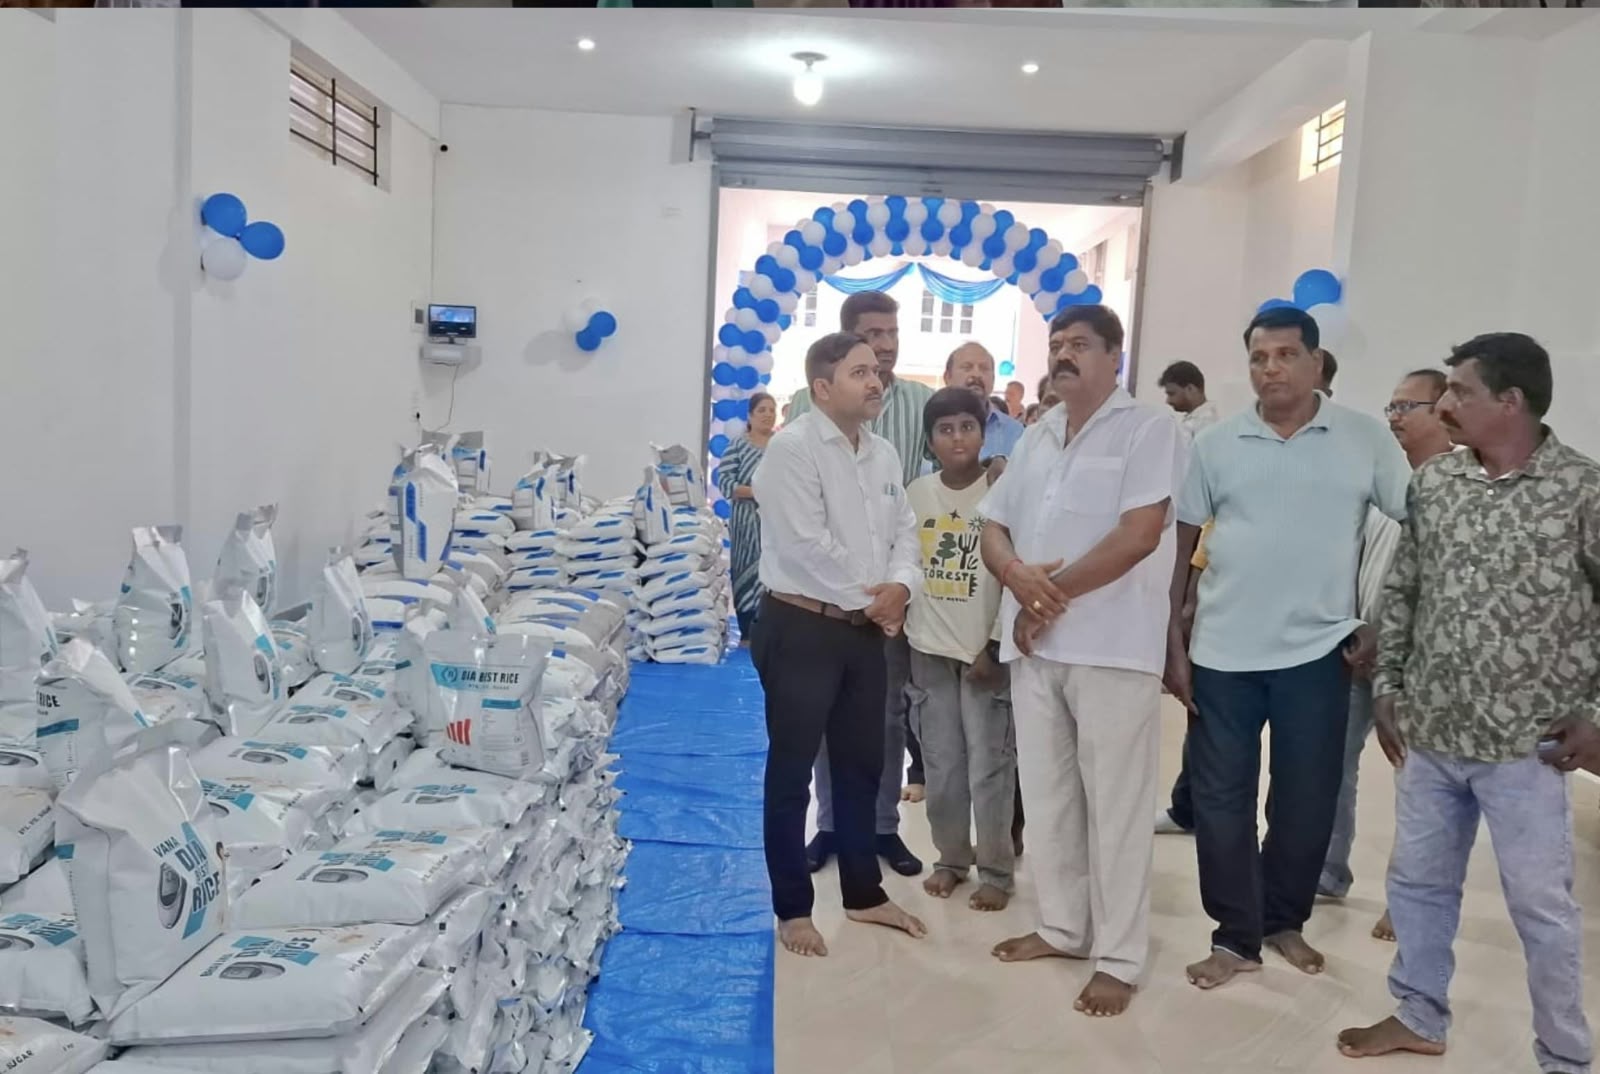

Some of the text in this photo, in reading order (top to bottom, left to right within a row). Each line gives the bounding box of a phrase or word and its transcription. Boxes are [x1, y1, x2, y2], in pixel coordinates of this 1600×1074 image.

[499, 672, 520, 684] RICE
[153, 836, 180, 857] VANA
[175, 840, 207, 872] DIA
[193, 871, 219, 911] RICE
[271, 936, 317, 959] RICE
